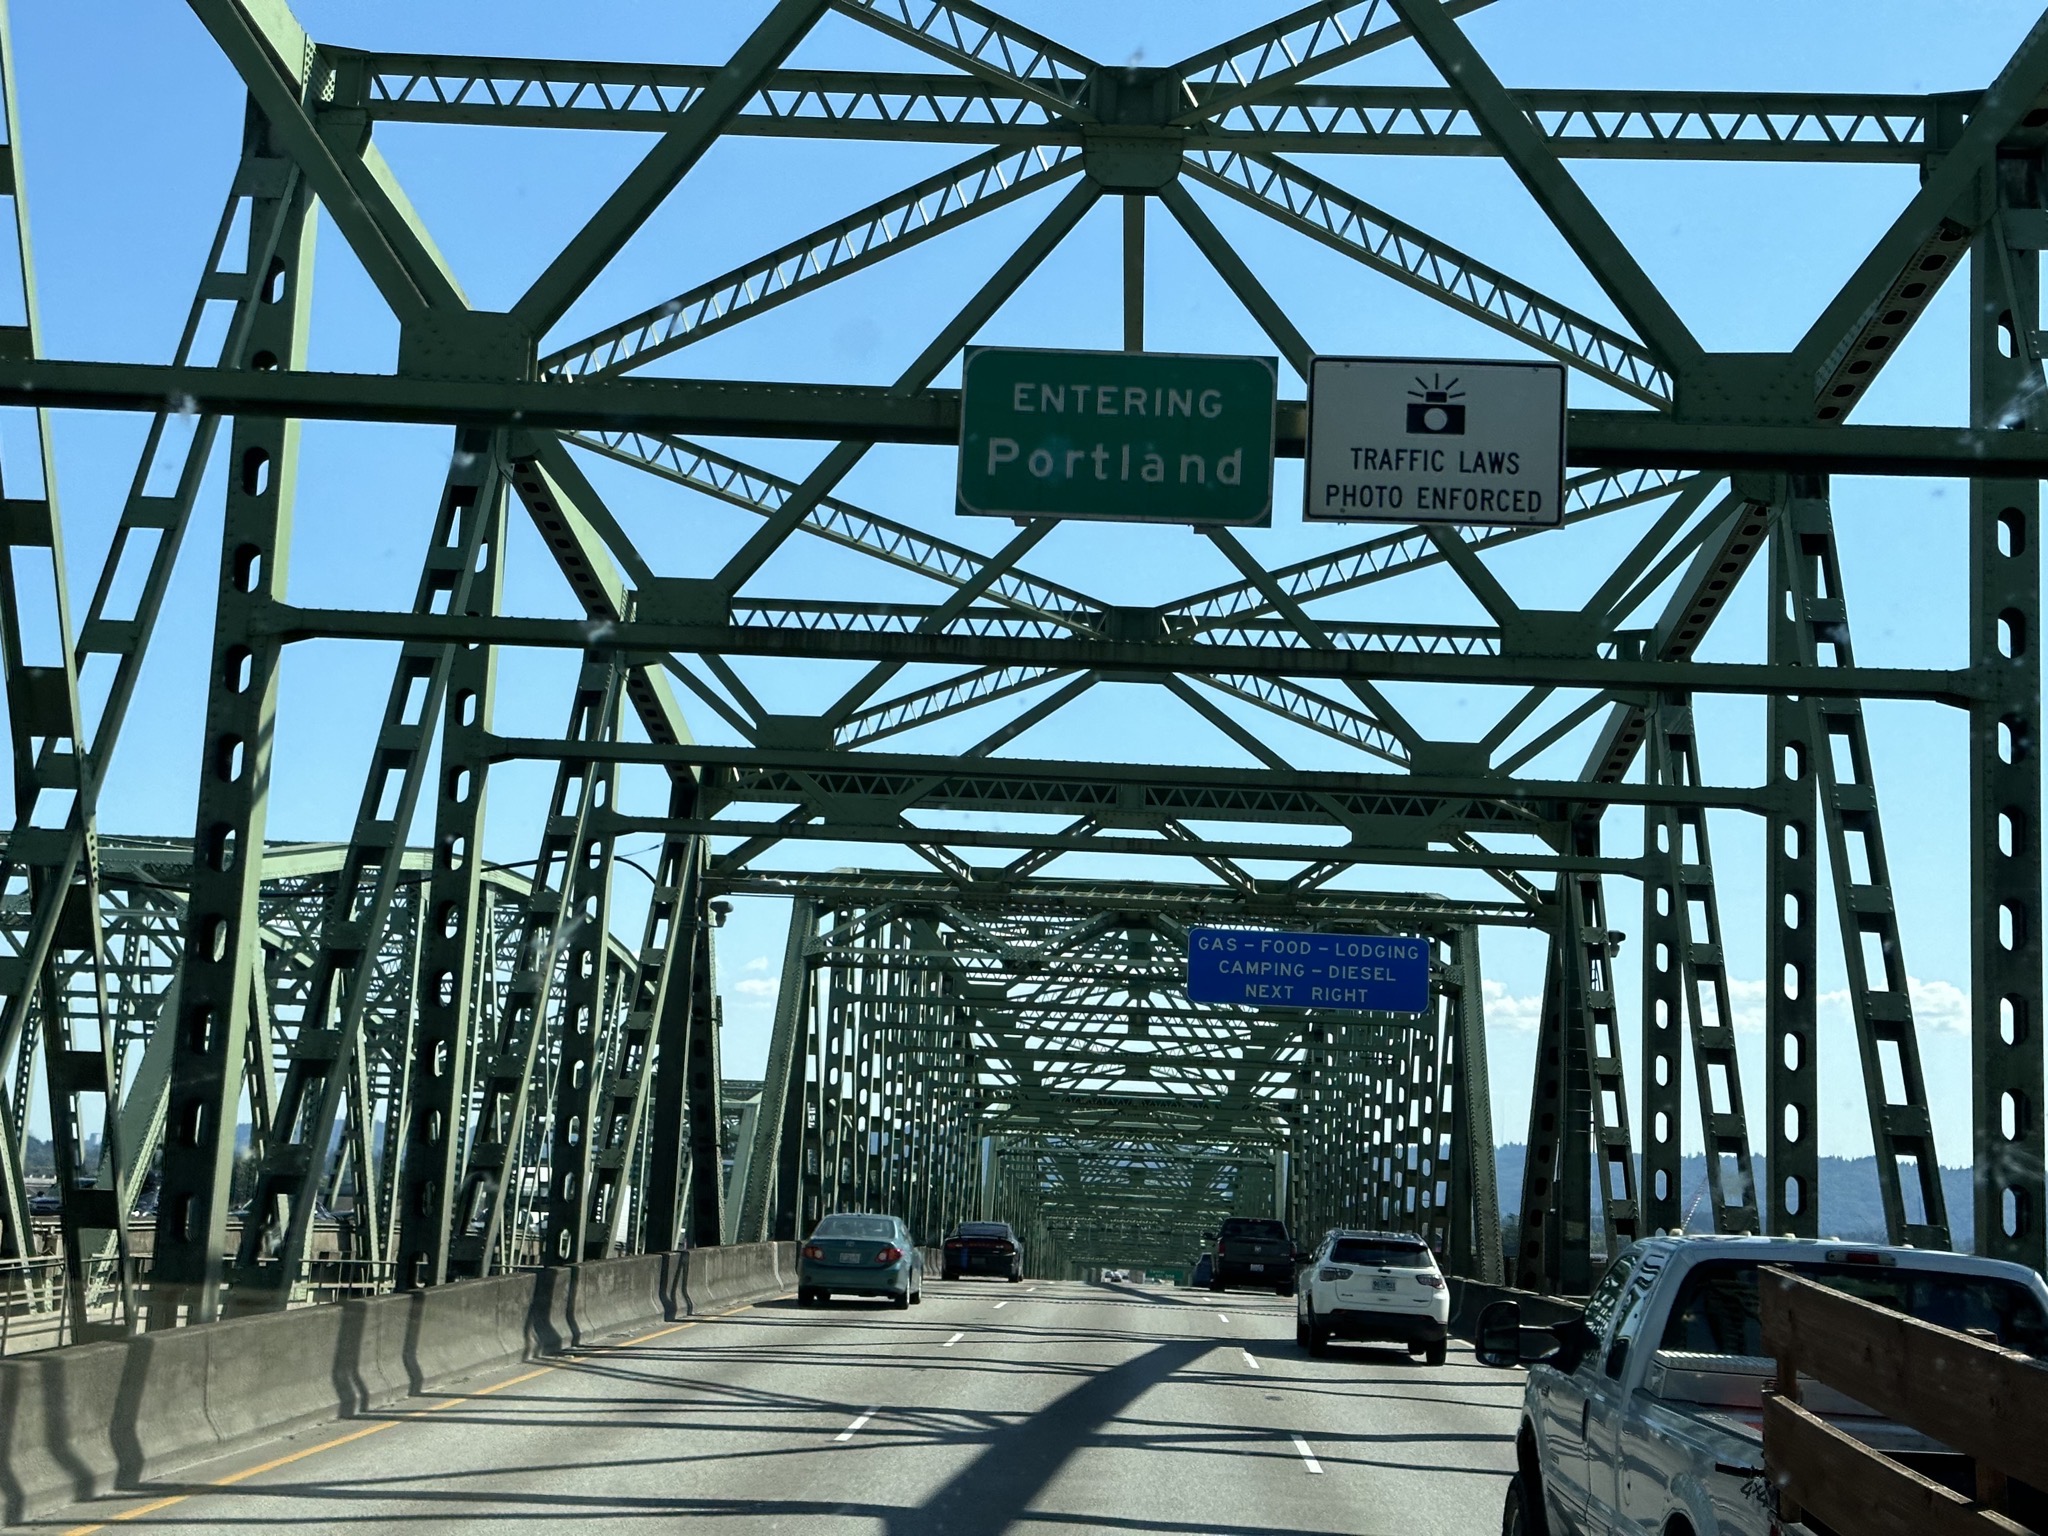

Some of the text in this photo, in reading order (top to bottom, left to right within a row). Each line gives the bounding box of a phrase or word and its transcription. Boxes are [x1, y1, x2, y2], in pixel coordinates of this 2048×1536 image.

[1013, 382, 1223, 419] ENTERING
[987, 436, 1242, 487] Portland
[1350, 447, 1520, 476] TRAFFIC LAWS
[1326, 484, 1542, 513] PHOTO ENFORCED
[1198, 936, 1237, 951] GAS
[1261, 940, 1311, 955] FOOD
[1335, 943, 1419, 960] LODGING
[1218, 960, 1305, 977] CAMPING
[1328, 965, 1396, 982] DIESEL
[1245, 984, 1368, 1002] NEXT RIGHT
